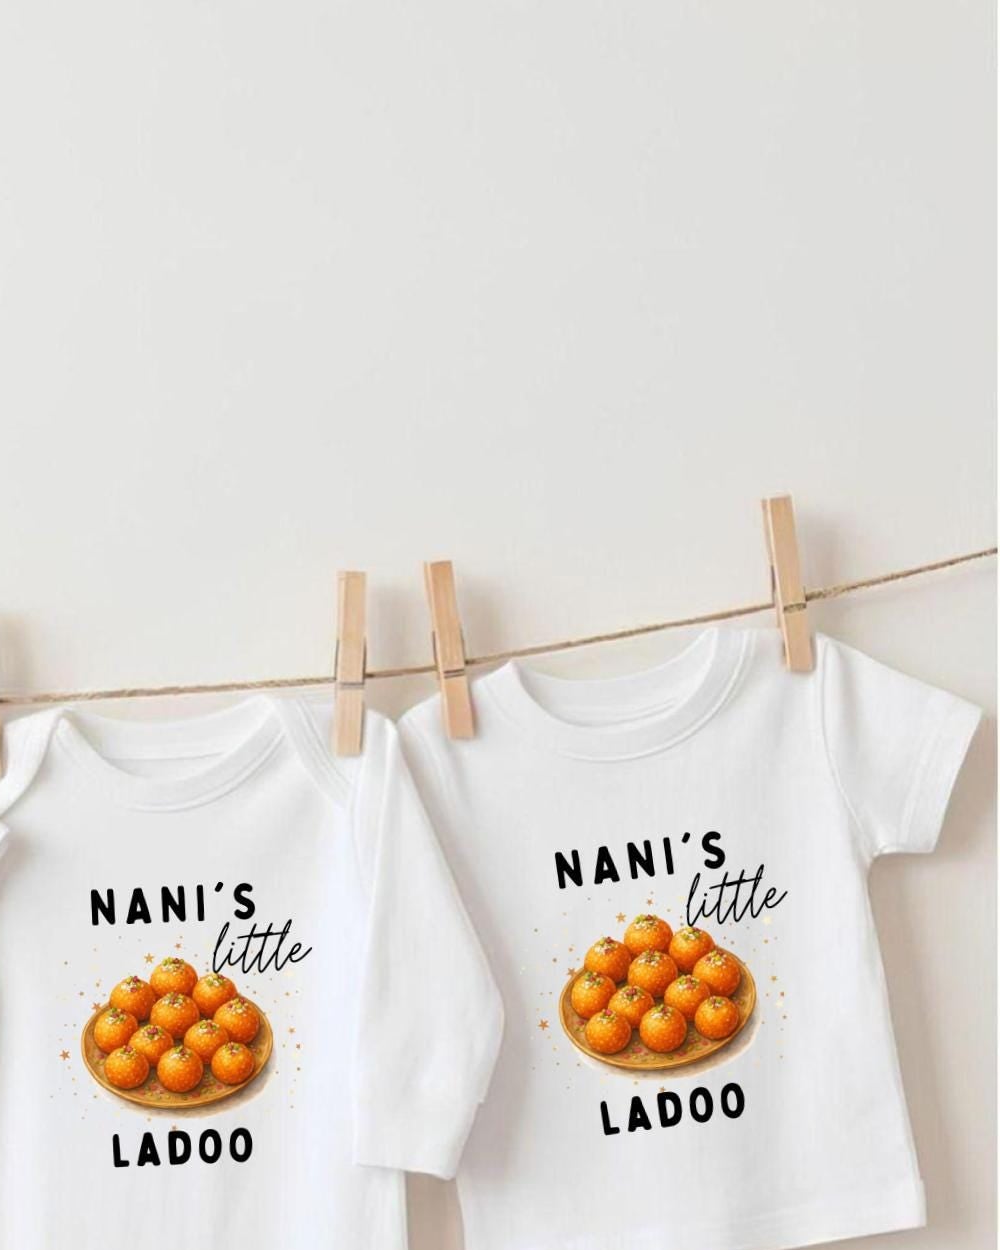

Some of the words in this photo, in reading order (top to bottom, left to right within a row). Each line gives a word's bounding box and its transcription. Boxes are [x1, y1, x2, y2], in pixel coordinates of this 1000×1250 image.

[554, 830, 726, 890] NANI'S
[90, 881, 256, 927] NANI'S
[685, 863, 789, 927] little
[211, 918, 313, 975] little
[599, 1082, 746, 1137] LADOO
[111, 1126, 254, 1168] LADOO
